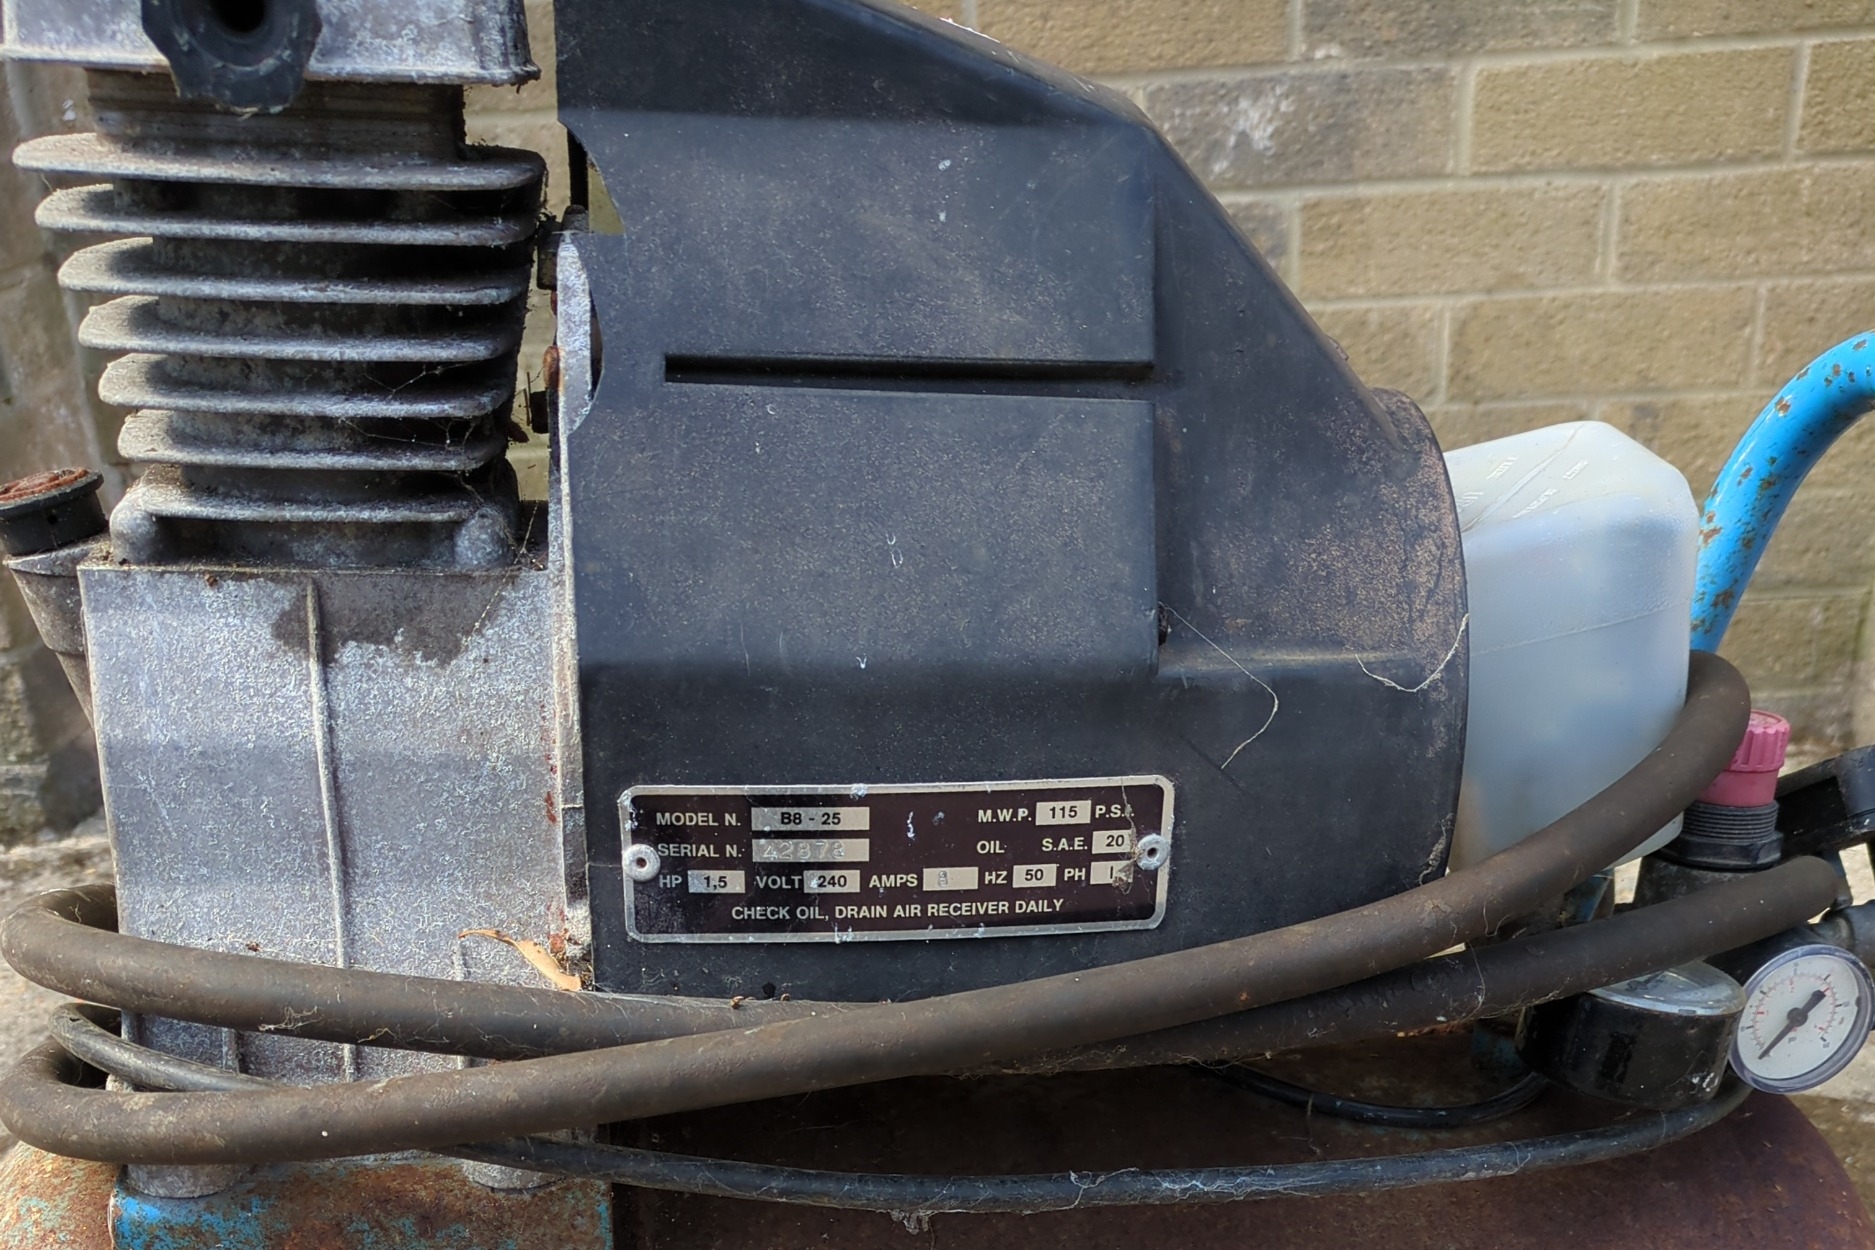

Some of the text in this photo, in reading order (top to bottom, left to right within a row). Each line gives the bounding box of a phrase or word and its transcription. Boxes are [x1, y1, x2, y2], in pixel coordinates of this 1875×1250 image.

[656, 812, 719, 826] MODEL
[725, 812, 741, 826] N.
[977, 804, 1135, 823] M.W.P. 115 P.S..
[657, 843, 719, 858] SERIAL
[976, 834, 1125, 854] OIL S.A.E. 20
[658, 874, 683, 888] HP
[703, 875, 728, 891] 1,5
[756, 875, 802, 889] VOLT
[817, 874, 848, 888] 240
[868, 874, 918, 888] AMPS
[984, 871, 1008, 885] HZ
[1024, 869, 1044, 882] 50
[1063, 868, 1086, 882] PH
[731, 898, 1064, 921] CHECK OIL, DRAIN AIR RECEIVER DAILY
